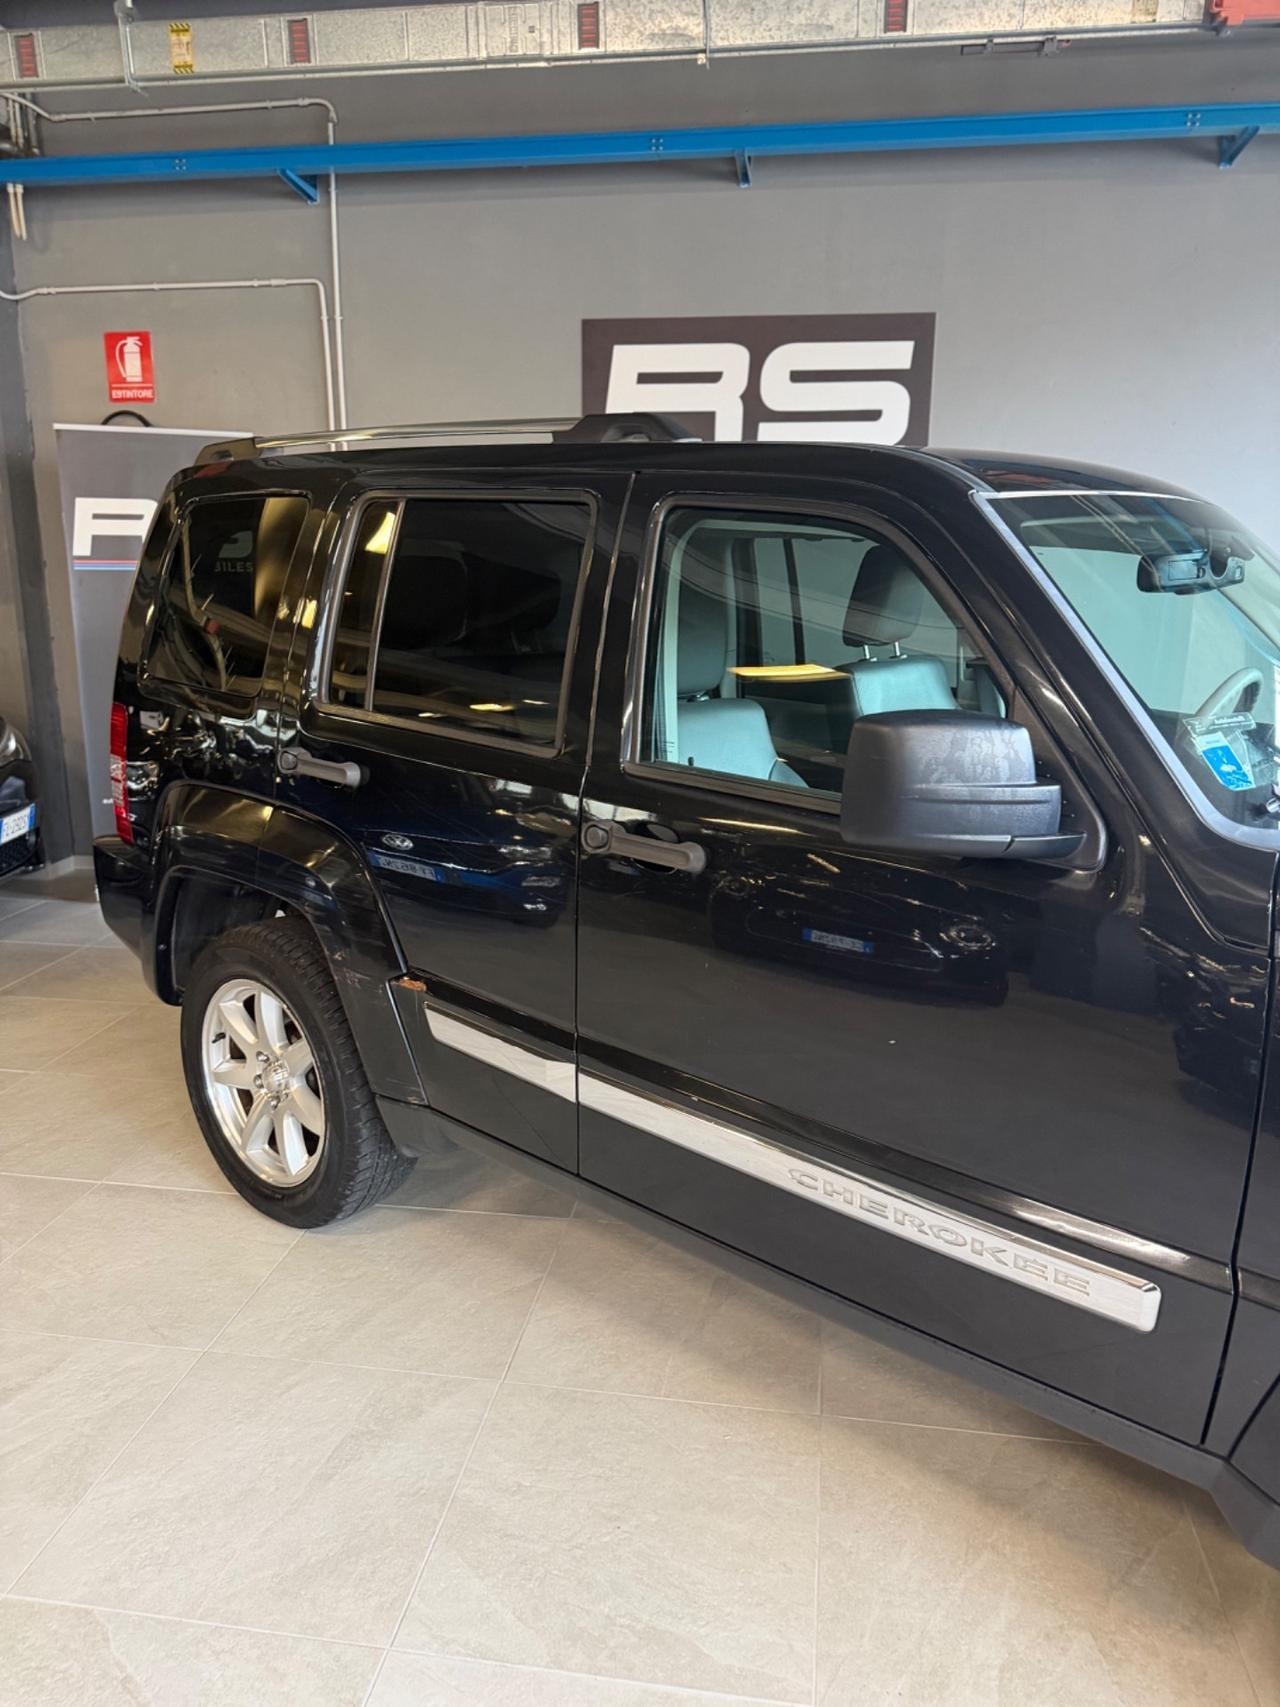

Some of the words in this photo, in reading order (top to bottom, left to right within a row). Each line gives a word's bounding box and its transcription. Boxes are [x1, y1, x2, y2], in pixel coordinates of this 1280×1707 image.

[111, 389, 154, 399] ESTINTORE
[605, 340, 915, 446] RS
[72, 497, 158, 556] R
[788, 1168, 1090, 1296] CHEROKEE
